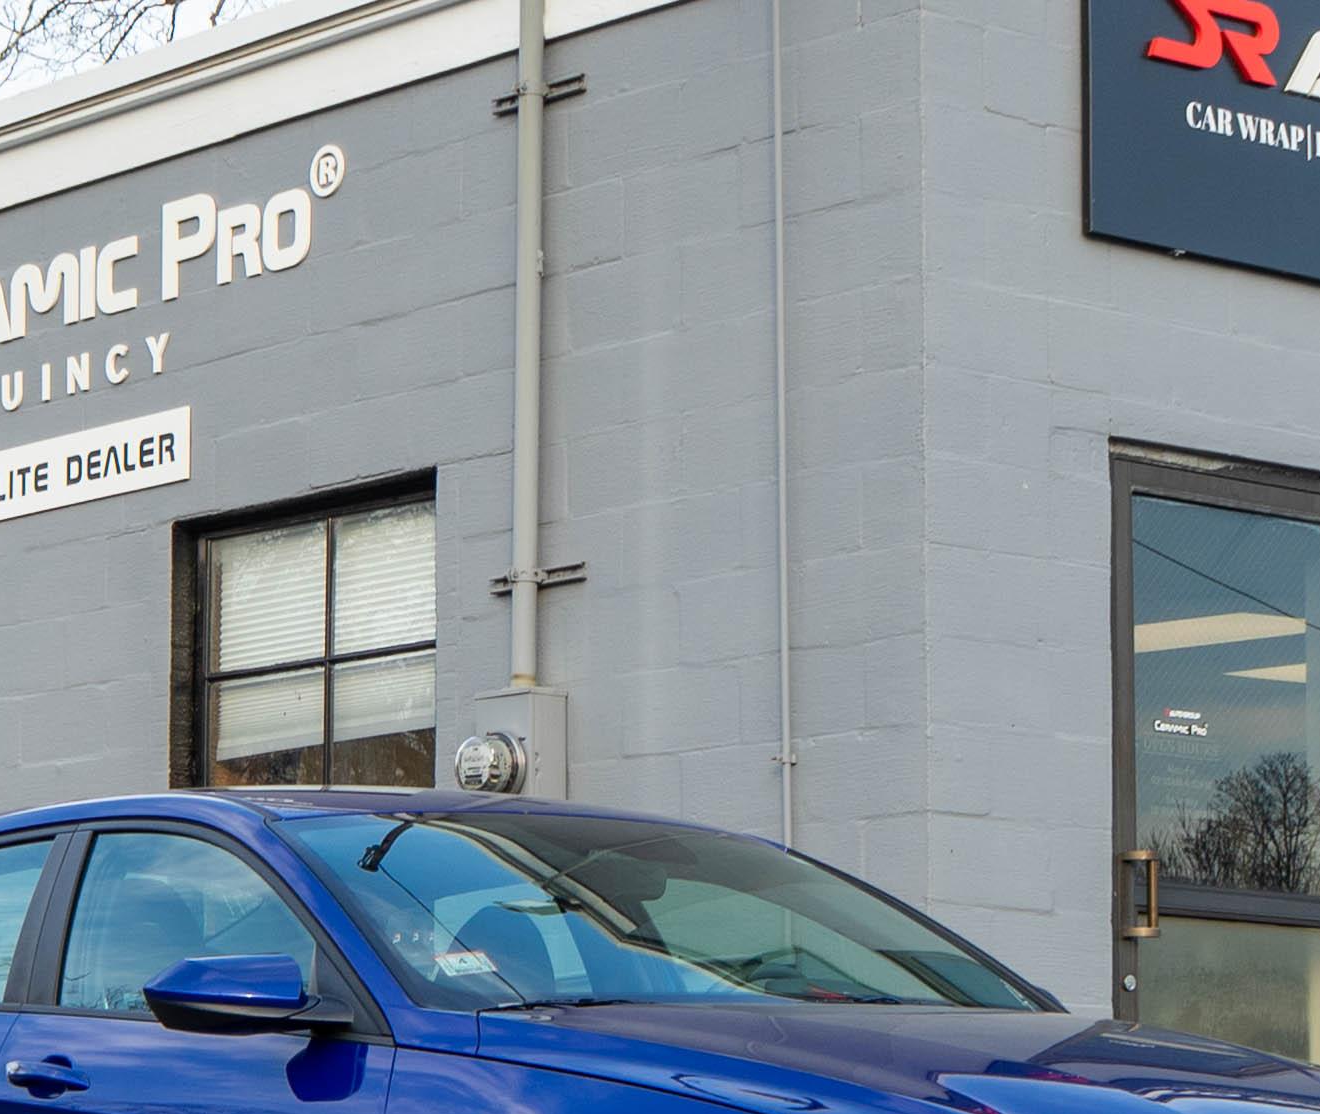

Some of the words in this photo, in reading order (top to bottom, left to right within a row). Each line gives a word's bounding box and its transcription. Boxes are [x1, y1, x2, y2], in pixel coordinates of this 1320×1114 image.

[1186, 101, 1234, 137] CAR
[1236, 112, 1305, 152] WRAP
[66, 432, 176, 487] DEALER
